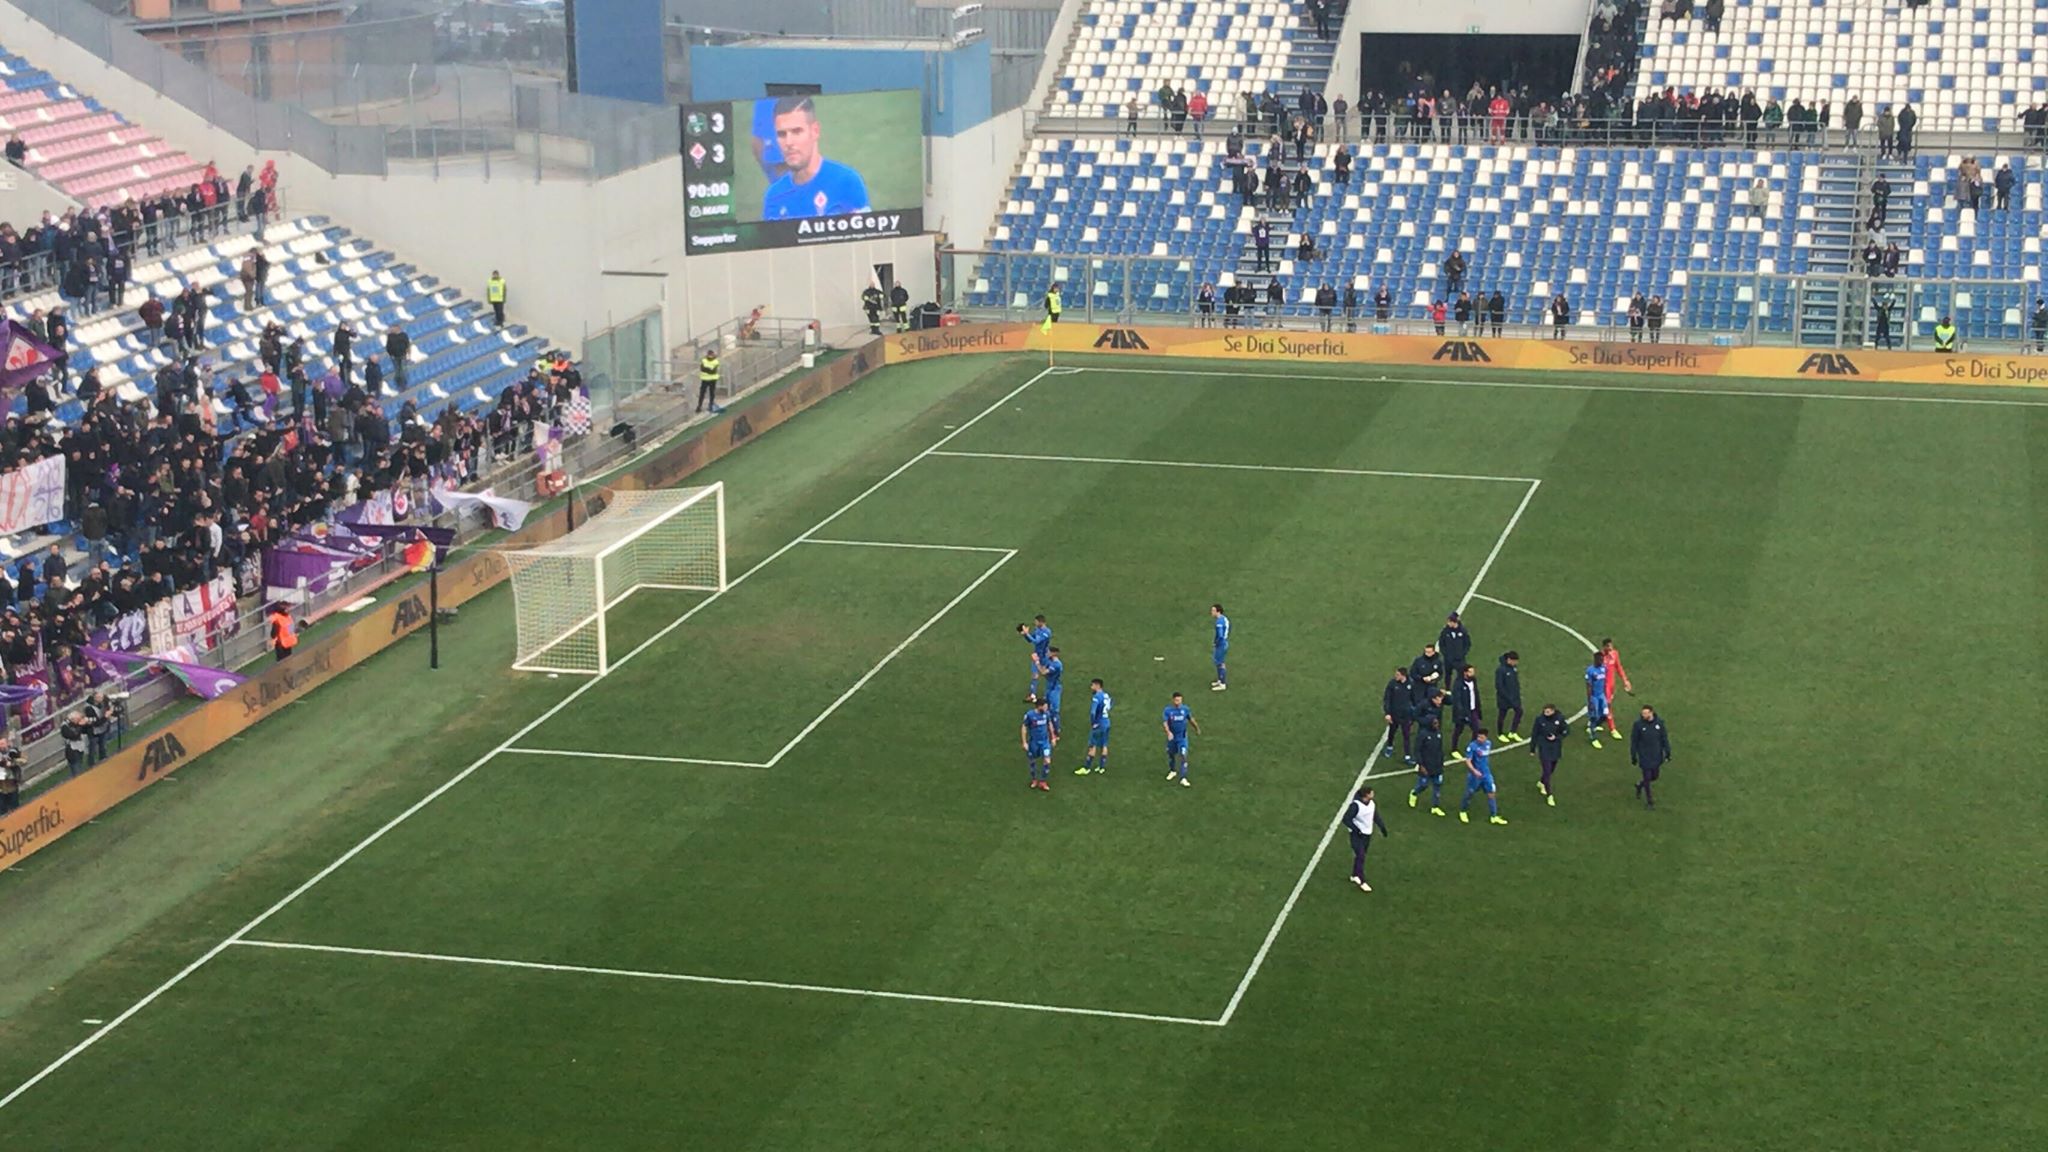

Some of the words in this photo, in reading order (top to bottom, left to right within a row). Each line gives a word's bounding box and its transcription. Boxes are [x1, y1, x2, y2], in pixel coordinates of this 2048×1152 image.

[711, 112, 725, 134] 3
[712, 144, 726, 164] 3
[687, 182, 730, 199] 90:00
[798, 214, 900, 235] AutoGepy
[899, 338, 914, 355] Se
[1093, 329, 1150, 350] FILA
[1224, 335, 1242, 352] Se
[1247, 335, 1274, 353] Dici
[1278, 336, 1348, 357] Superfici.
[1432, 341, 1491, 362] FILA
[1569, 346, 1588, 364] Se
[1593, 347, 1622, 365] Dici
[1797, 353, 1860, 375] FILA
[1945, 359, 1965, 378] Se
[1971, 360, 2001, 379] Dici
[138, 732, 187, 781] FILA
